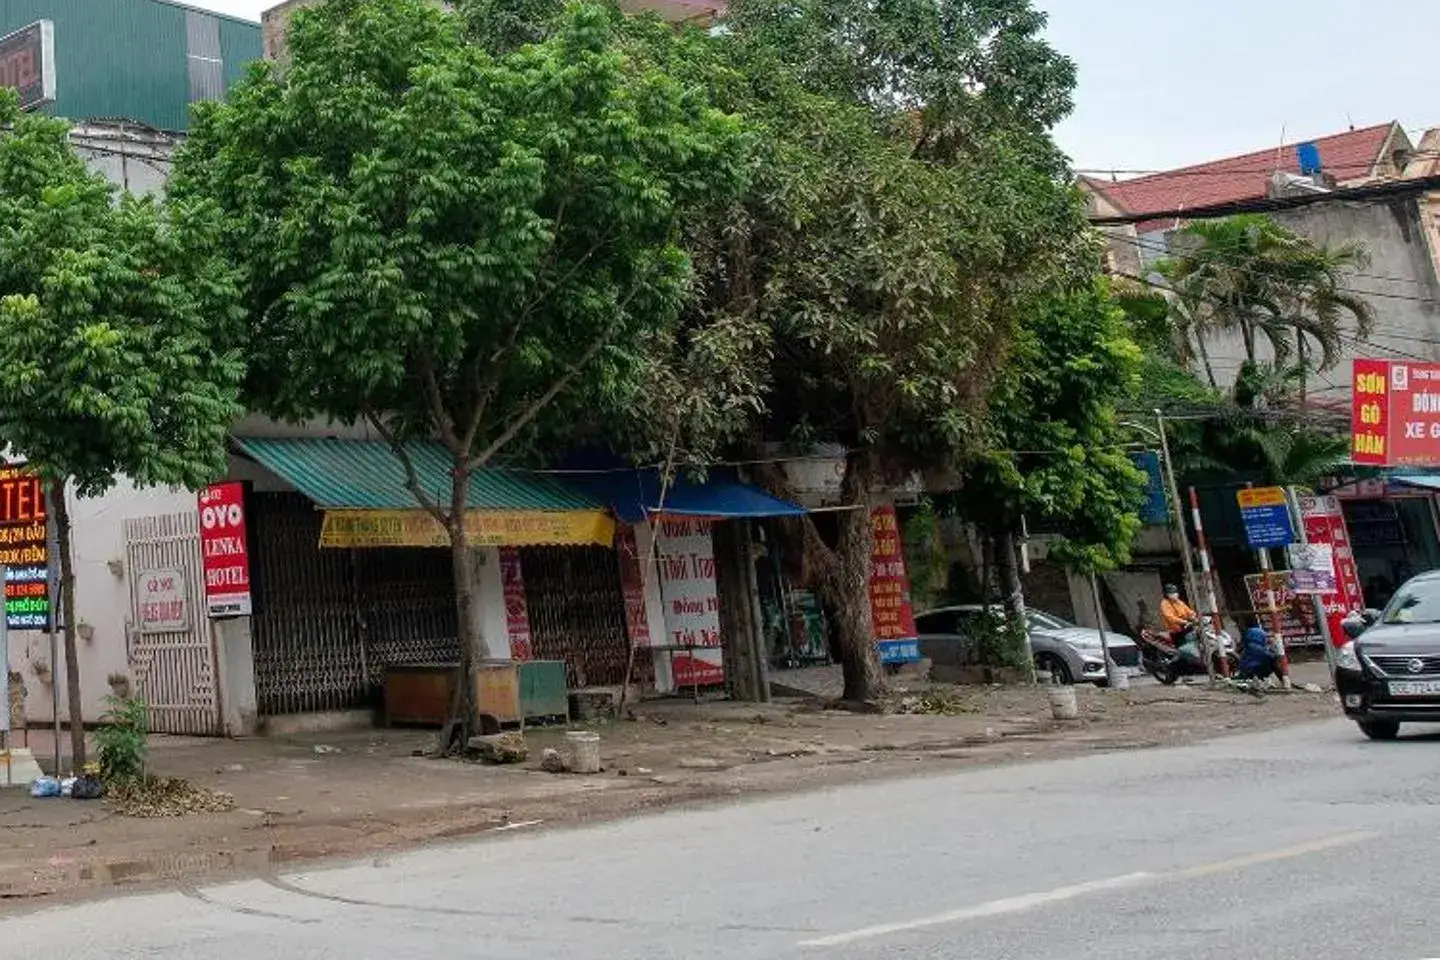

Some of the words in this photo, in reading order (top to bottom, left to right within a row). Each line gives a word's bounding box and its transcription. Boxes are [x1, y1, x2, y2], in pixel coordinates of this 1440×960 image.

[1356, 371, 1385, 395] SƠN
[1361, 400, 1381, 425] GÒ
[1405, 422, 1426, 439] XE
[202, 503, 242, 529] OYO
[204, 536, 245, 557] LENKA
[206, 565, 249, 587] HOTEL
